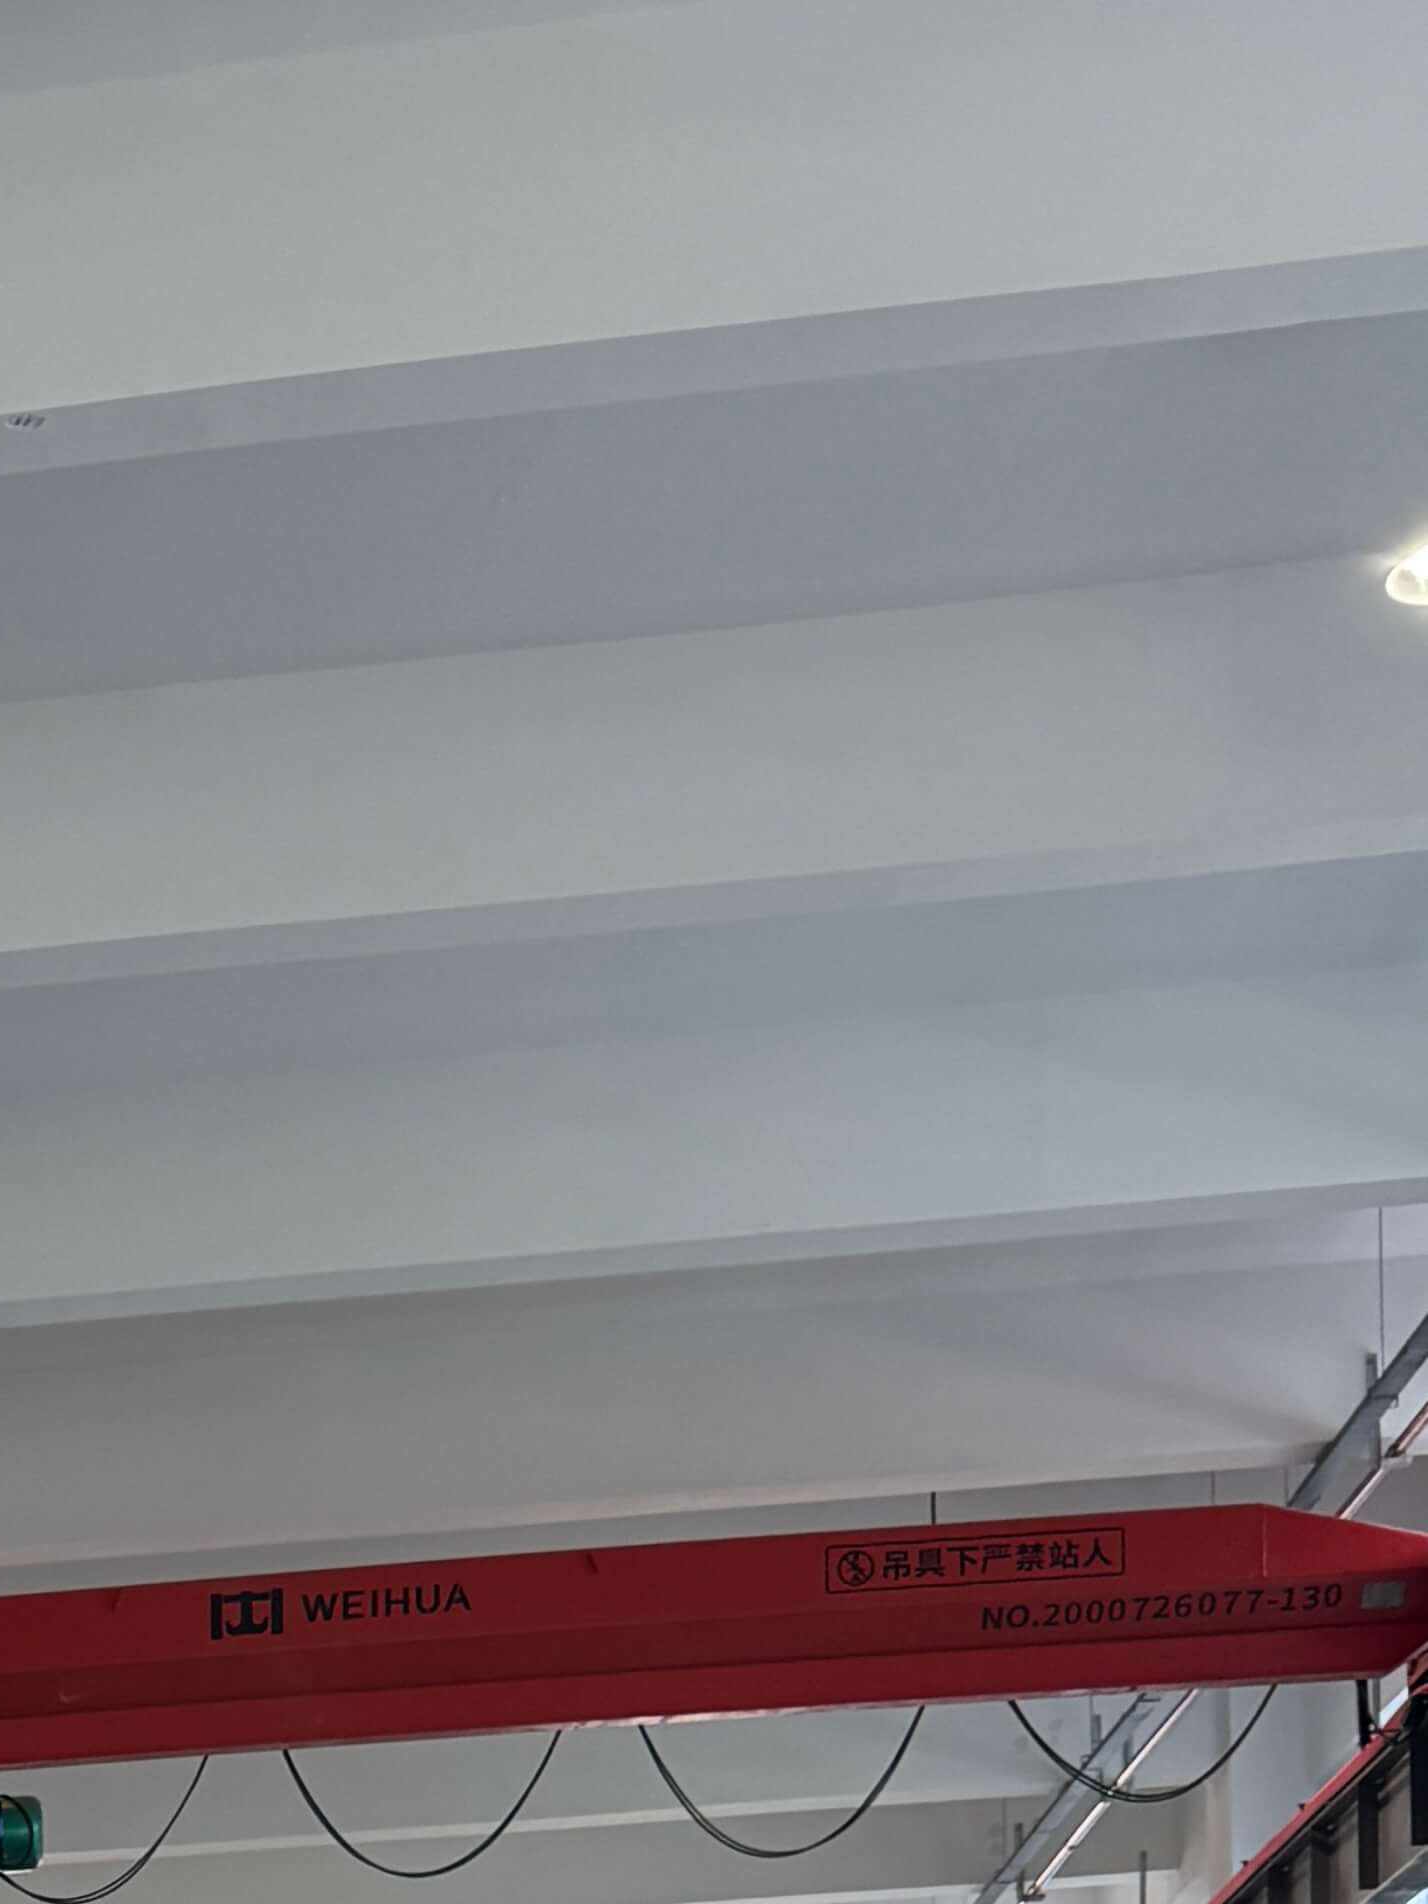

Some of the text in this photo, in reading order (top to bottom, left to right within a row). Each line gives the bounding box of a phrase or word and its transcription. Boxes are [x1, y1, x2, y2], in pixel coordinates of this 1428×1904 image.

[881, 1537, 1113, 1581] 吊具下严禁站人
[300, 1583, 472, 1623] WEIHUA
[980, 1583, 1344, 1631] NO.2000726077-130
